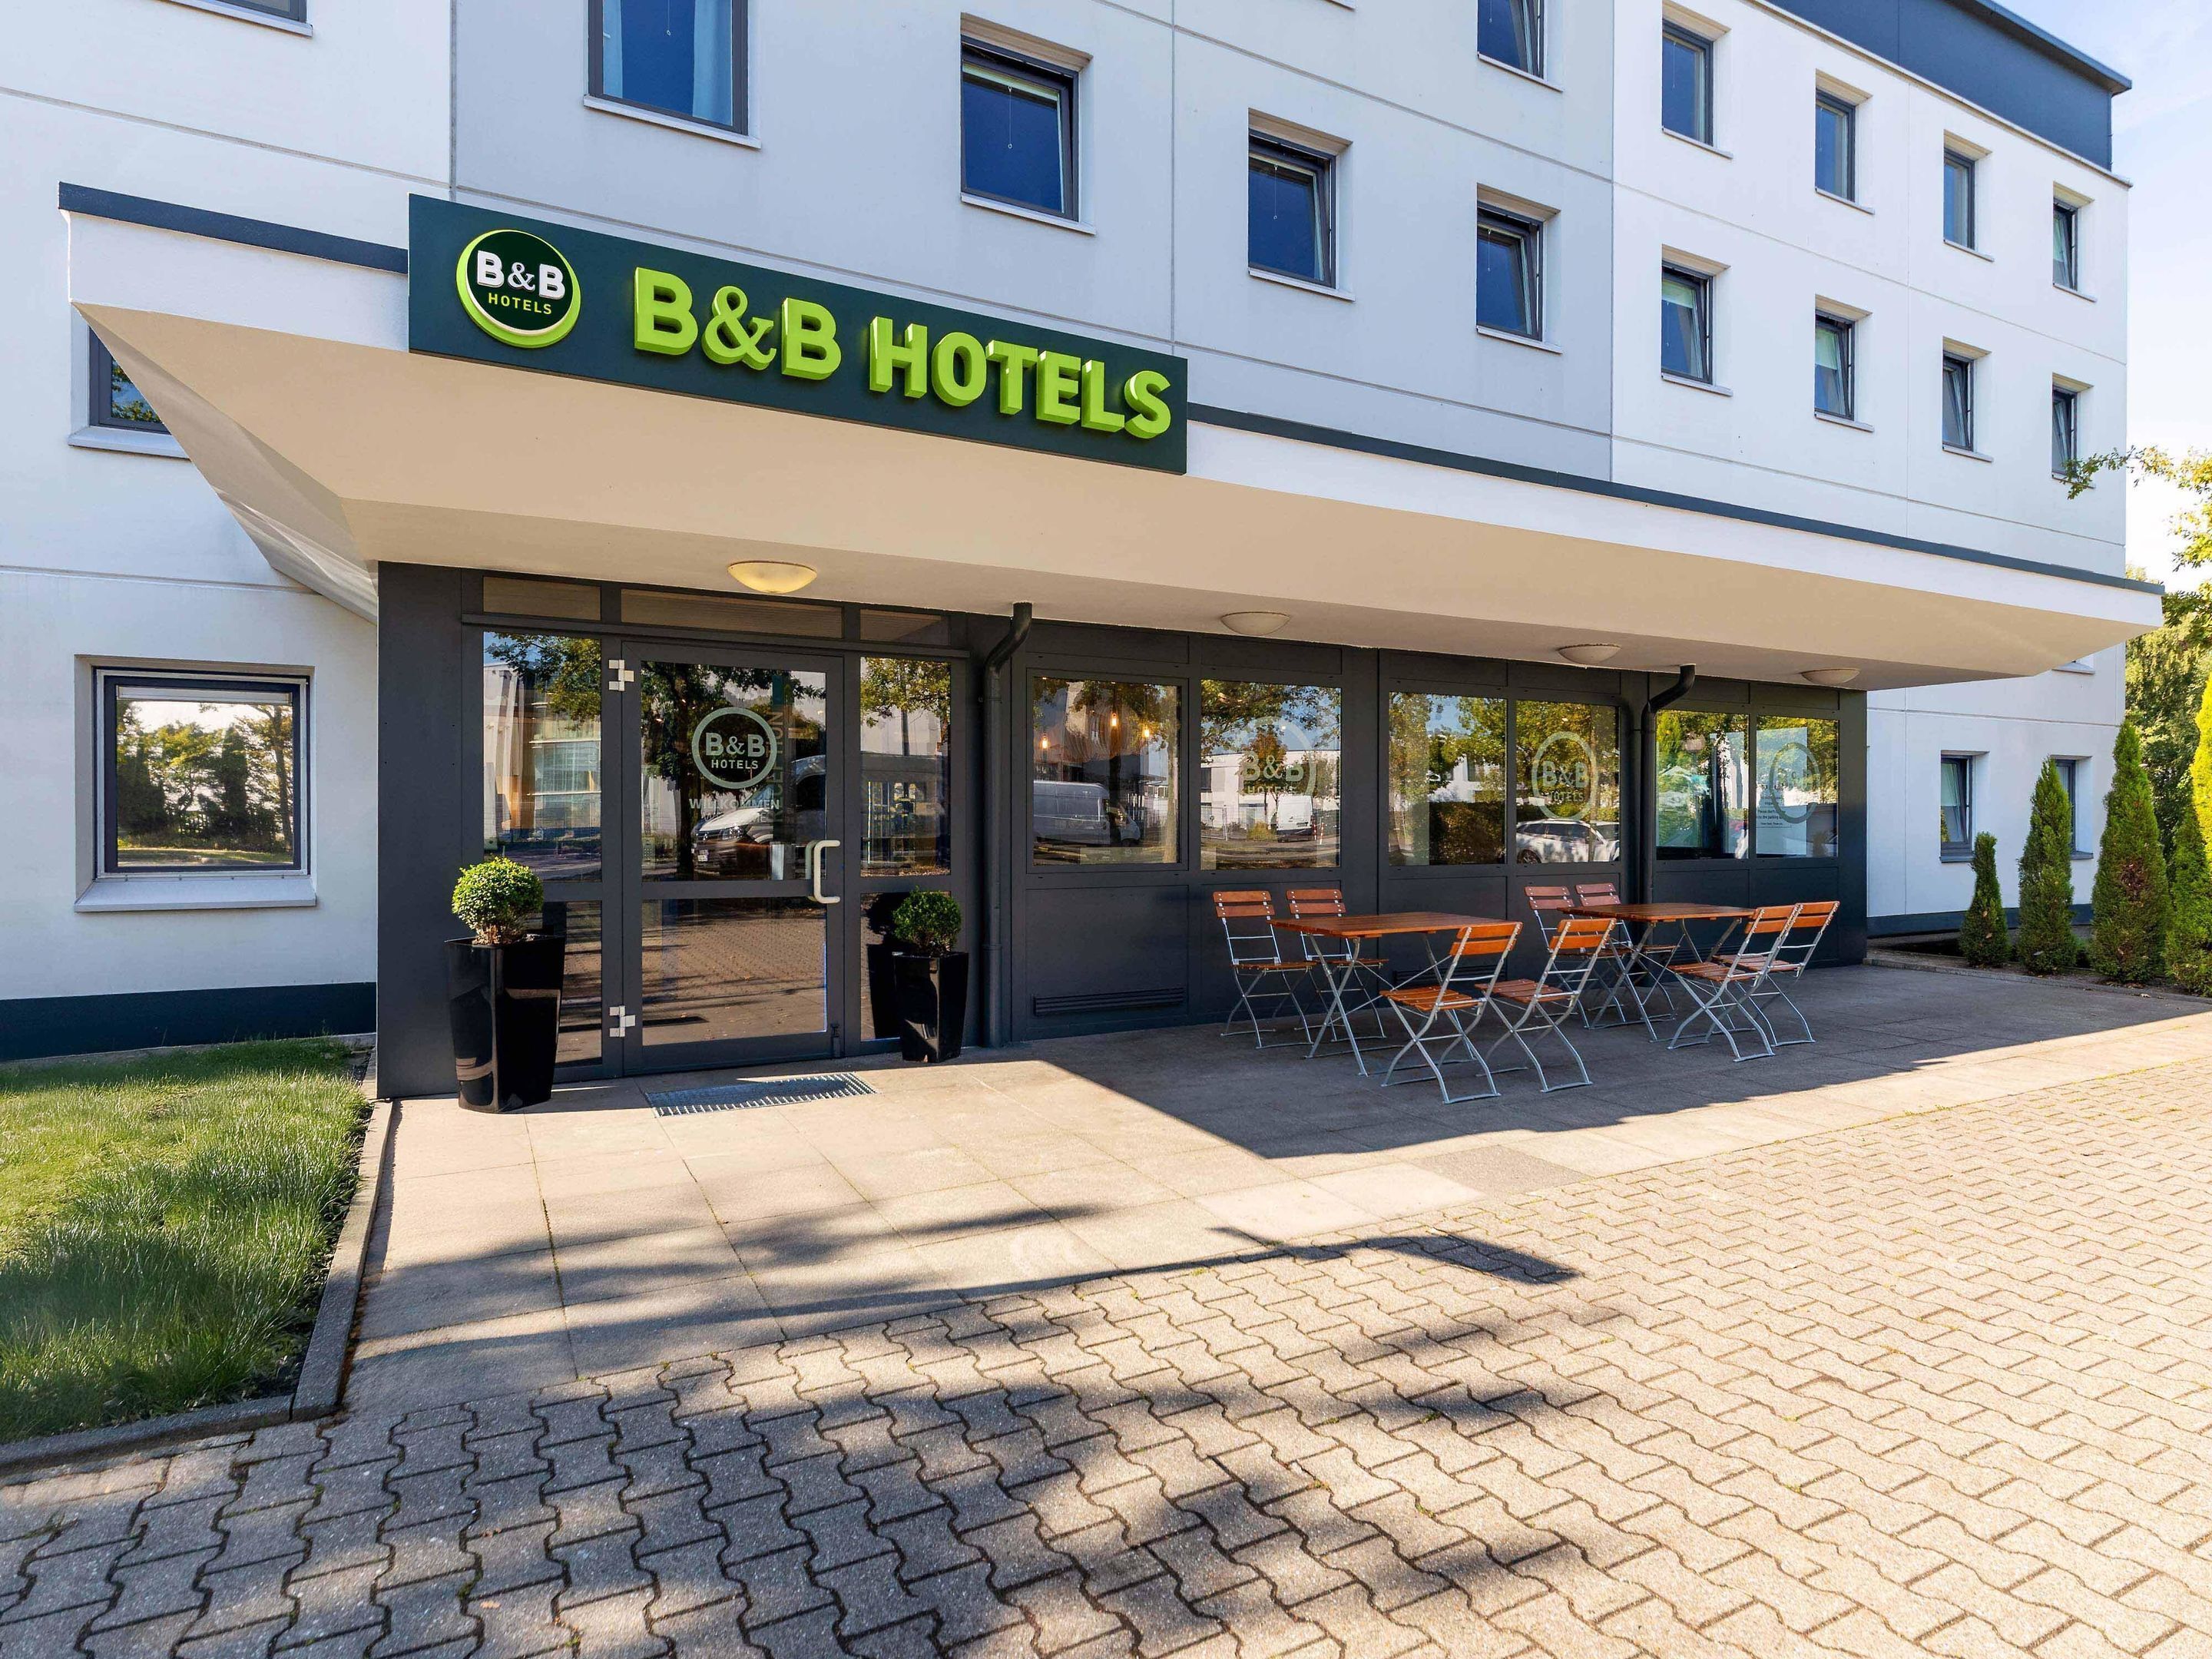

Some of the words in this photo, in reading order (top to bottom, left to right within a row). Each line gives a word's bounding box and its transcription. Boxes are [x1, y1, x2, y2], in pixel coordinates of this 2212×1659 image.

[477, 250, 565, 300] B&B
[488, 293, 552, 315] HOTELS
[634, 267, 842, 380] B&B
[869, 316, 1171, 439] HOTELS
[705, 732, 766, 757] B&B
[710, 759, 759, 769] HOTELS
[1542, 760, 1589, 788] B&B
